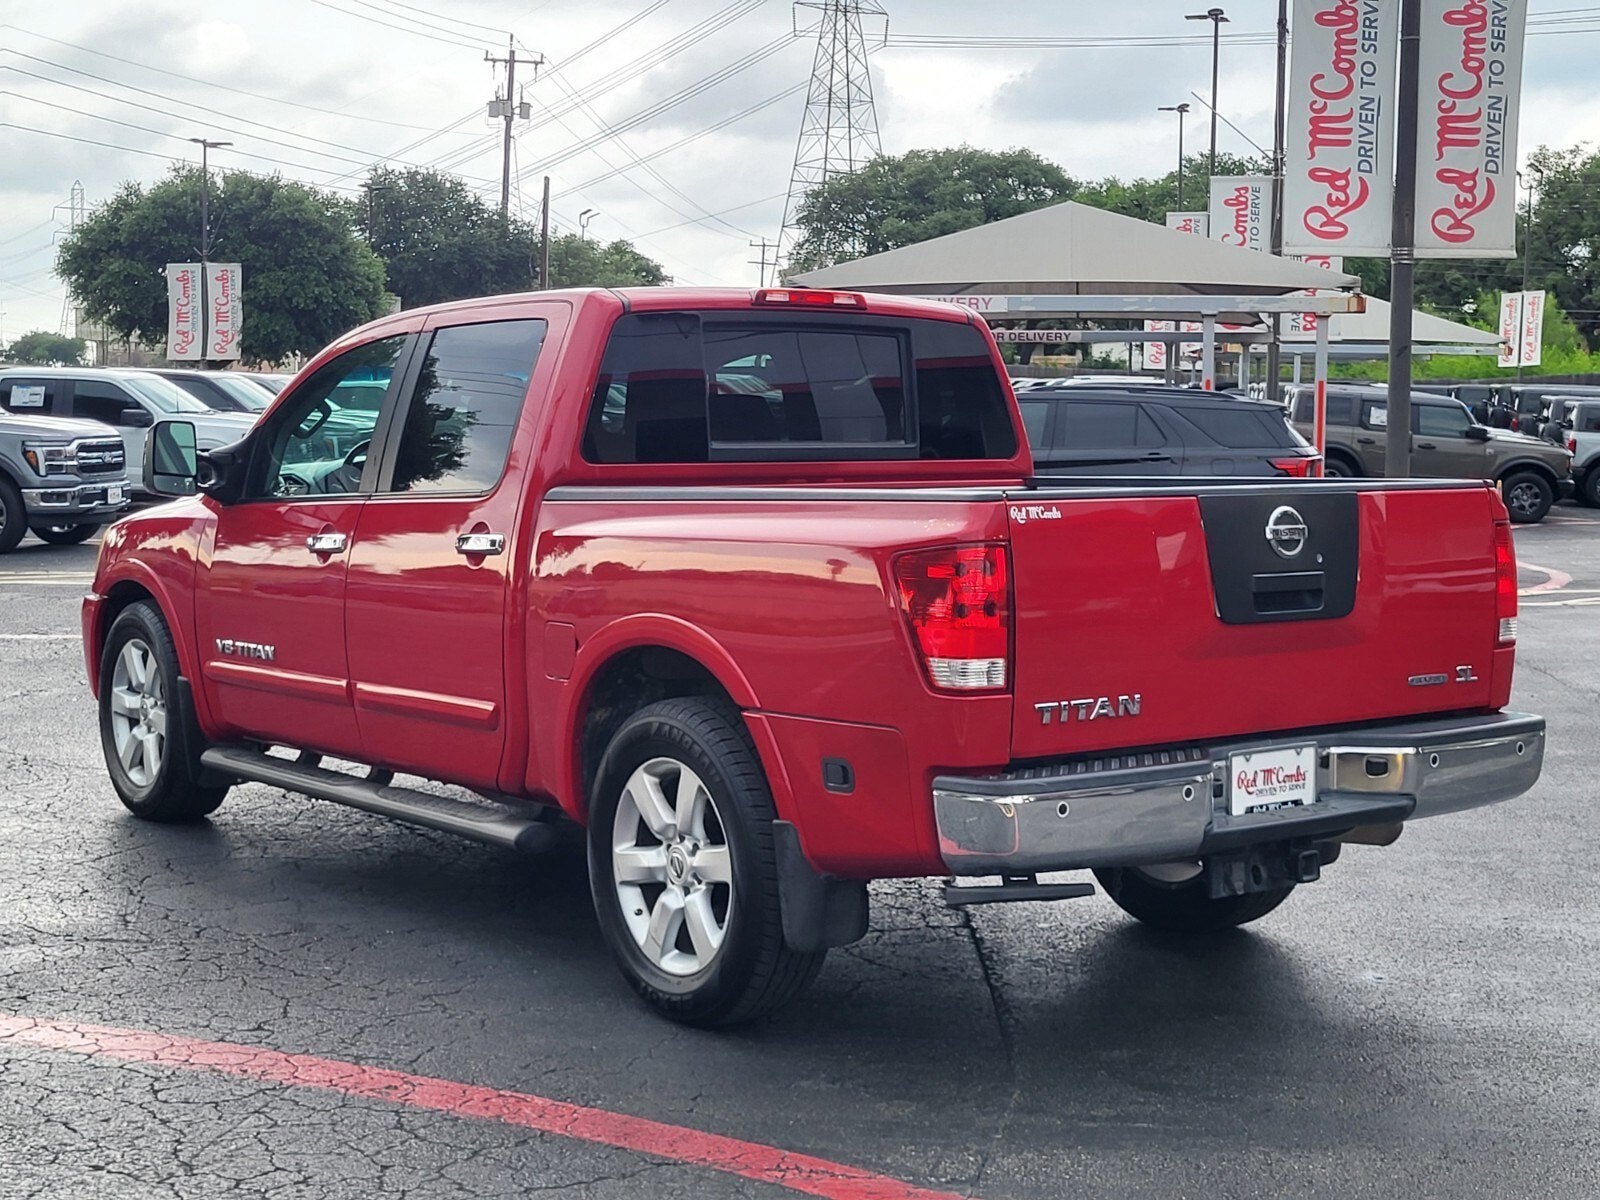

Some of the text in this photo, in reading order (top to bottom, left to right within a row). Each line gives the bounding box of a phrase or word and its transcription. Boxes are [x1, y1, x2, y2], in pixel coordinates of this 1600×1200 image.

[1307, 0, 1359, 161] McComb
[1357, 0, 1379, 175] DRIVEN TO SERV
[1484, 0, 1508, 175] DRIVEN TO SERV
[1431, 0, 1496, 243] Red McComb
[1221, 186, 1249, 247] Combs
[1250, 186, 1261, 223] SERVE
[1303, 166, 1369, 240] Red
[1249, 226, 1260, 243] TO
[173, 269, 195, 354] Red McCombs
[191, 294, 197, 303] TO
[213, 269, 236, 354] Red McCombs
[1009, 331, 1071, 342] DELIVERY
[1010, 506, 1062, 524] Red McCombs
[1034, 694, 1141, 724] TITAN
[1237, 765, 1307, 795] Red McCombs
[1279, 784, 1288, 792] TO
